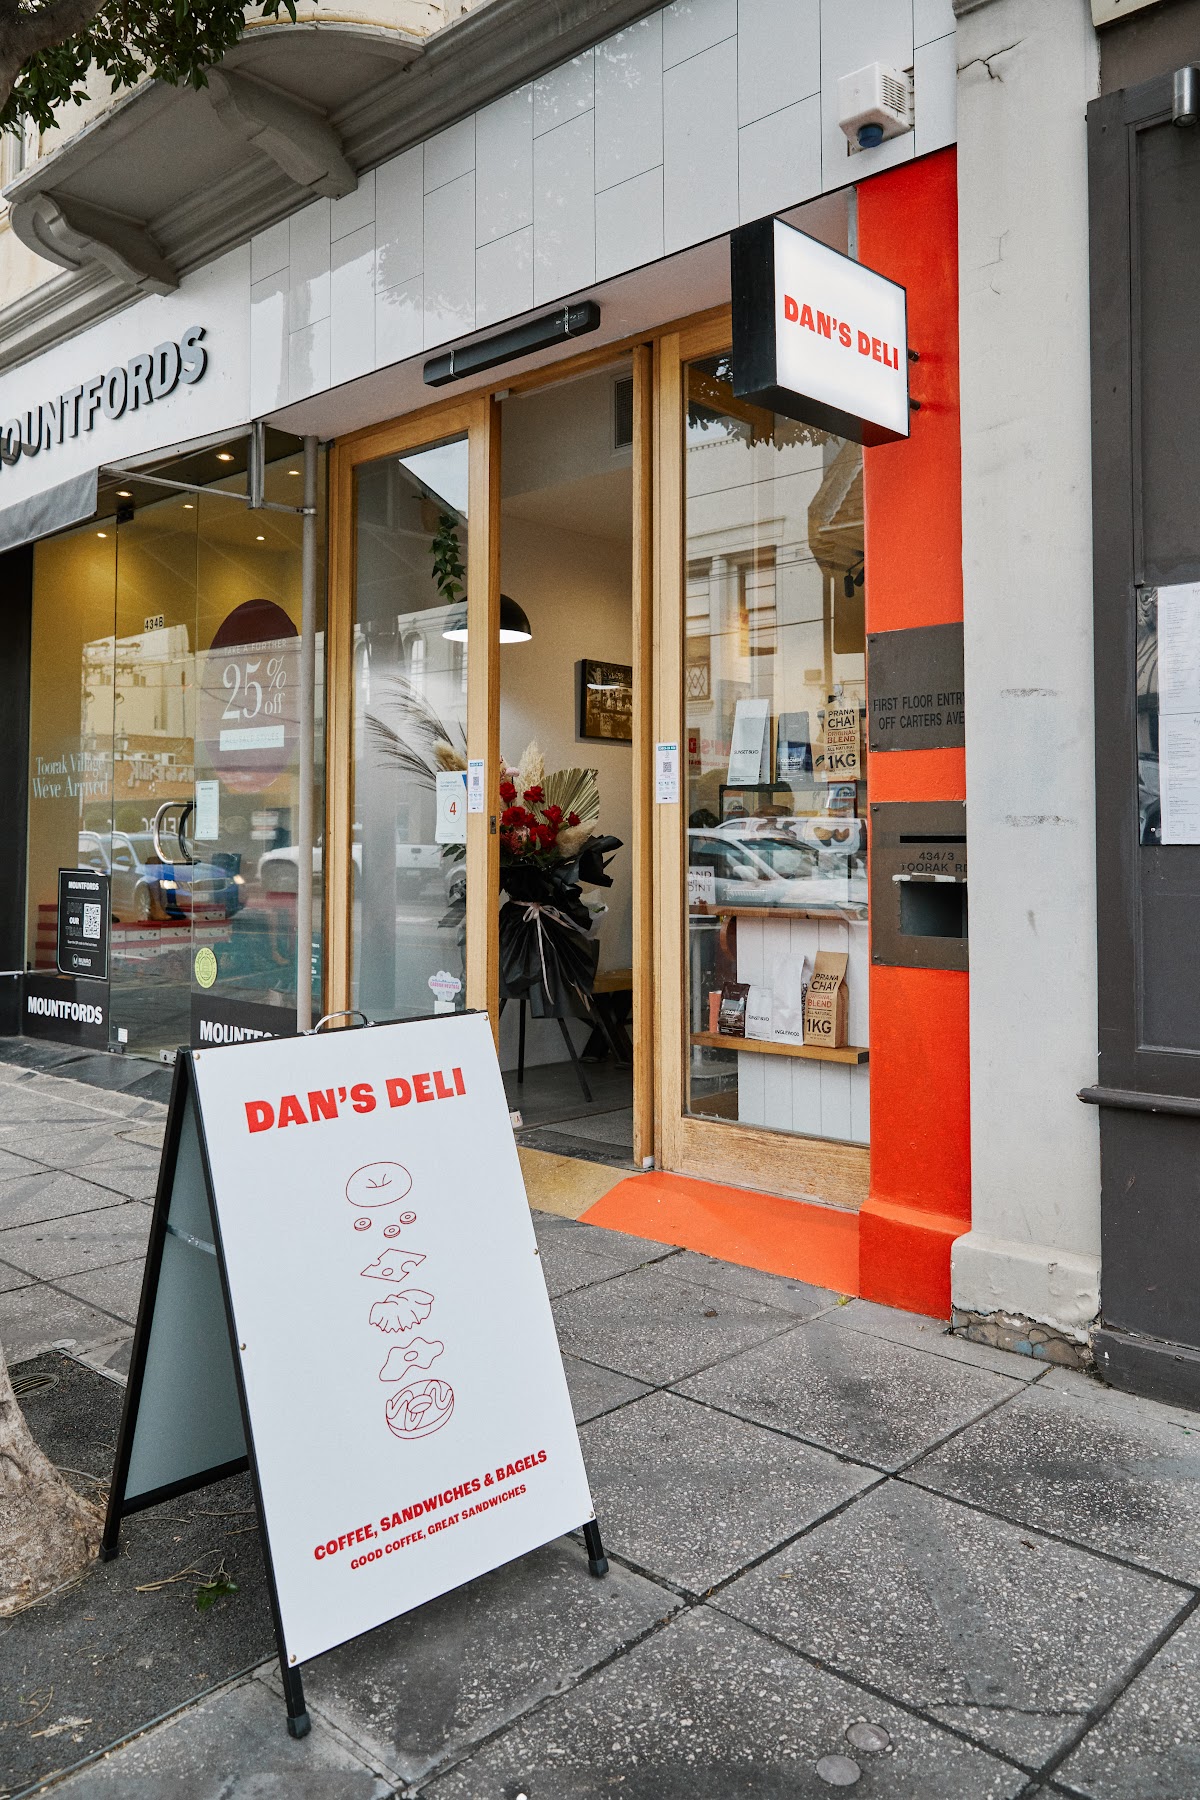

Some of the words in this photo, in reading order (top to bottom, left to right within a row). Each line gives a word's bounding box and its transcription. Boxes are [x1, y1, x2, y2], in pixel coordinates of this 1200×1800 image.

[784, 293, 852, 348] DAN'S
[858, 329, 899, 371] DELI
[0, 325, 208, 471] OUNTFORDS
[144, 616, 164, 630] 434B
[224, 647, 240, 655] TAKE
[251, 640, 287, 651] FURTHER
[264, 693, 286, 715] off
[873, 697, 898, 711] FIRST
[902, 694, 933, 709] FLOOR
[937, 691, 965, 707] ENTR
[828, 708, 855, 718] PRANA
[878, 716, 896, 730] OFF
[900, 712, 942, 729] CARTERS
[946, 711, 965, 725] AVE
[827, 715, 855, 728] CHAI
[827, 736, 856, 744] BLEND
[36, 754, 68, 775] Toorak
[828, 753, 856, 769] 1KG
[63, 772, 108, 798] Arrived
[449, 801, 457, 815] 4
[918, 852, 955, 861] 434/3
[68, 881, 100, 891] MOUNTFORDS
[69, 917, 80, 925] OUR
[815, 973, 839, 981] PRANA
[811, 980, 837, 991] CHAI
[27, 995, 103, 1025] MOUNTFORDS
[807, 999, 832, 1008] BLEND
[807, 1018, 832, 1034] 1KG
[244, 1082, 377, 1134] DAN'S
[385, 1067, 467, 1109] DELI
[313, 1523, 378, 1561] COFFEE,
[380, 1477, 482, 1532] SANDWICHES
[483, 1472, 495, 1487] &
[495, 1449, 548, 1482] BAGELS
[350, 1547, 383, 1570] GOOD
[384, 1530, 427, 1555] COFFEE,
[427, 1513, 460, 1535] GREAT
[461, 1484, 527, 1520] SANDWICHES
